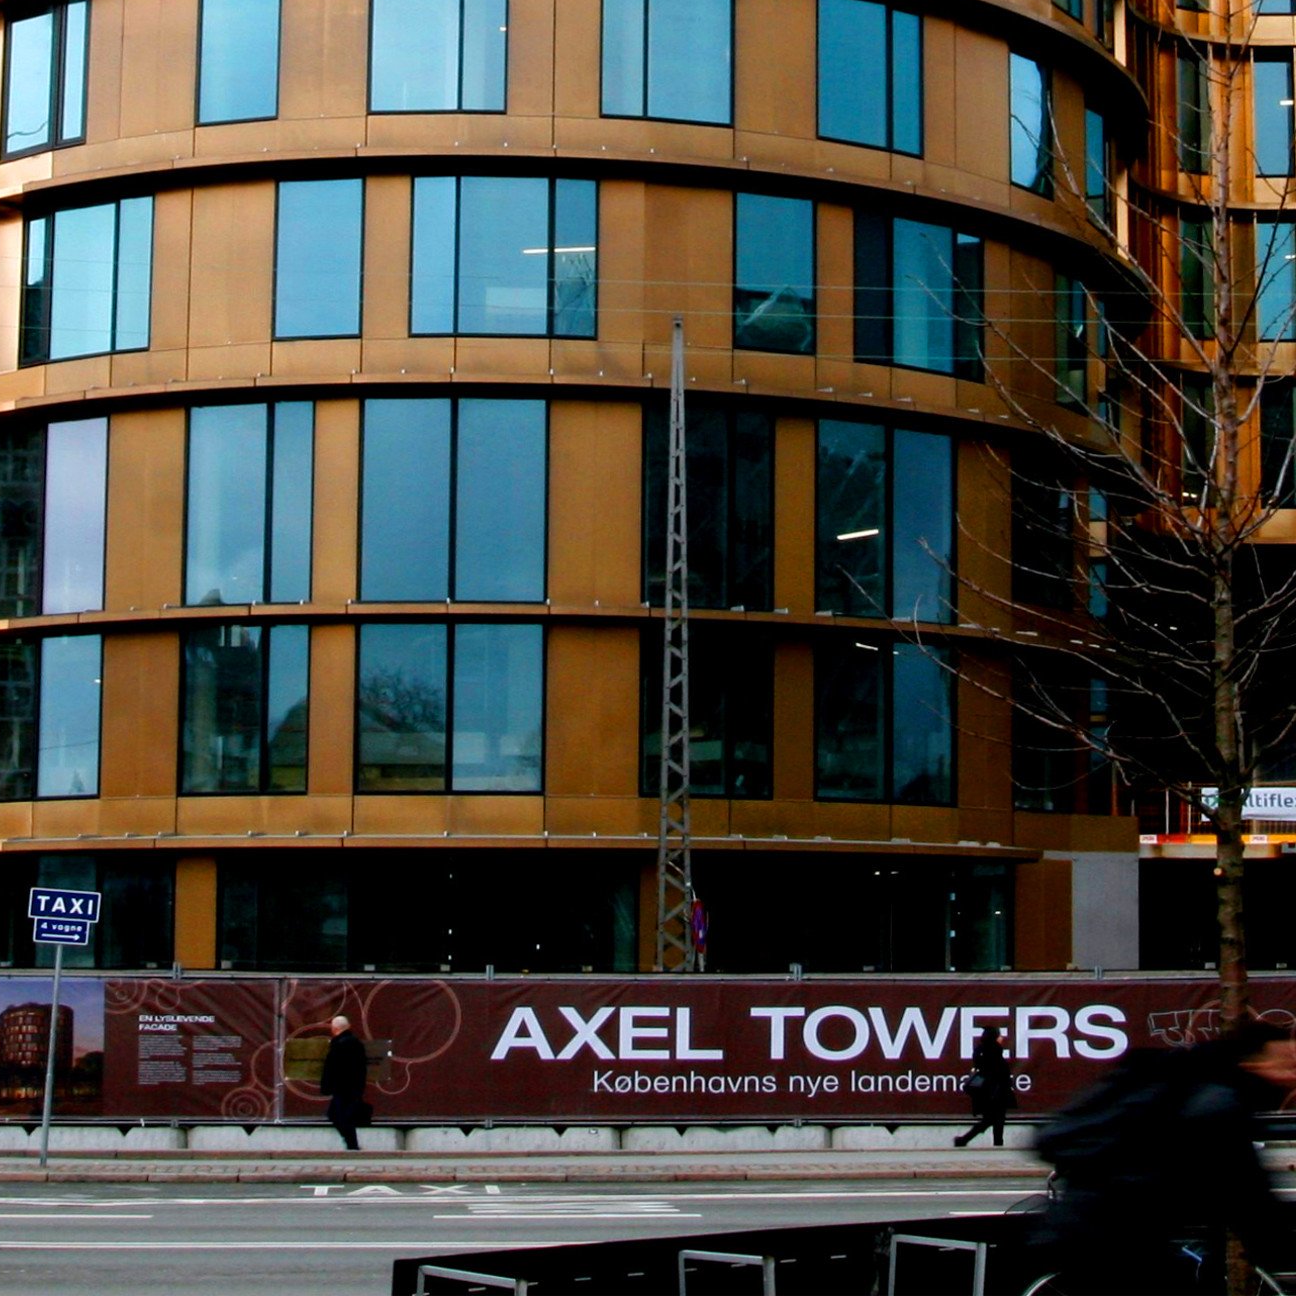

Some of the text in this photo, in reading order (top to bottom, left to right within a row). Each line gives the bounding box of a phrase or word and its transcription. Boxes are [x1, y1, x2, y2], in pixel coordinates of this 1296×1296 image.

[37, 895, 93, 915] TAXI
[52, 924, 83, 932] vogne
[138, 1014, 153, 1022] EN
[490, 1007, 723, 1060] AXEL
[750, 1005, 1129, 1061] TOWERS
[593, 1070, 1032, 1098] Københavns nye landeme
